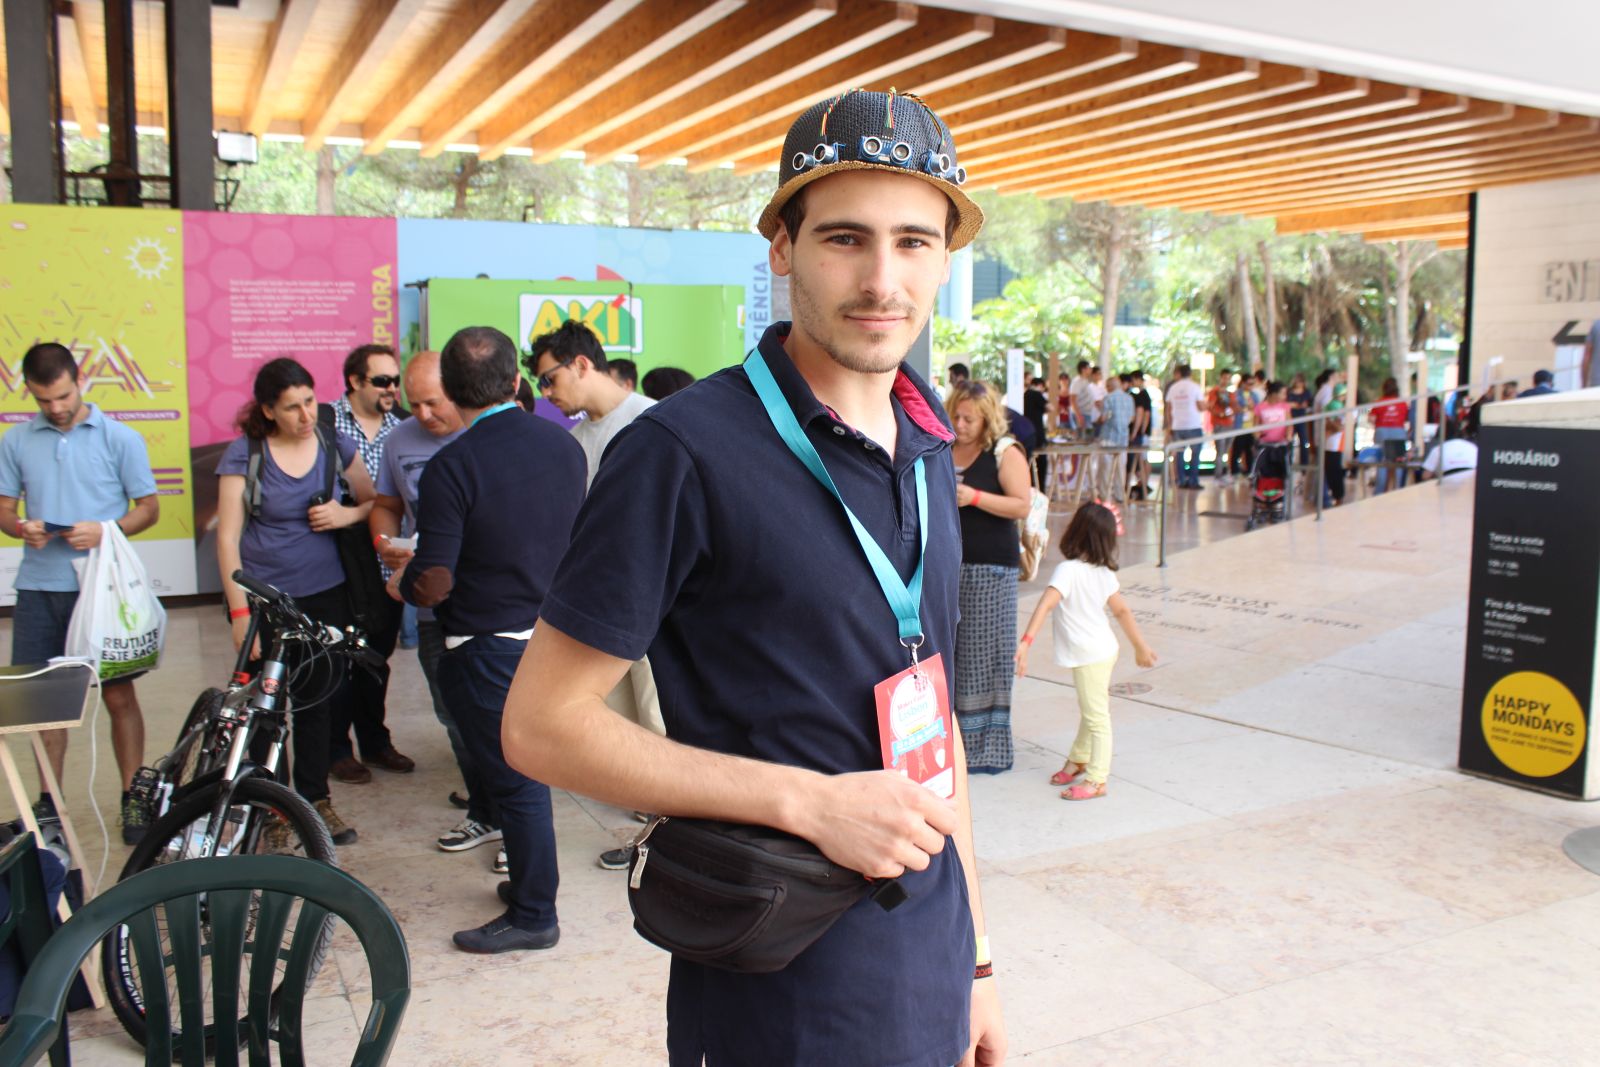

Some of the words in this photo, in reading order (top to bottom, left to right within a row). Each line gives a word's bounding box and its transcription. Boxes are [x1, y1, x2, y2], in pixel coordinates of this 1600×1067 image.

[1493, 449, 1560, 467] HORÁRIO
[1491, 478, 1527, 490] OPENING
[1528, 481, 1558, 491] HOURS
[101, 650, 129, 661] ESTE
[132, 640, 159, 659] SACO
[1494, 693, 1552, 716] HAPPY
[1492, 707, 1576, 737] MONDAYS
